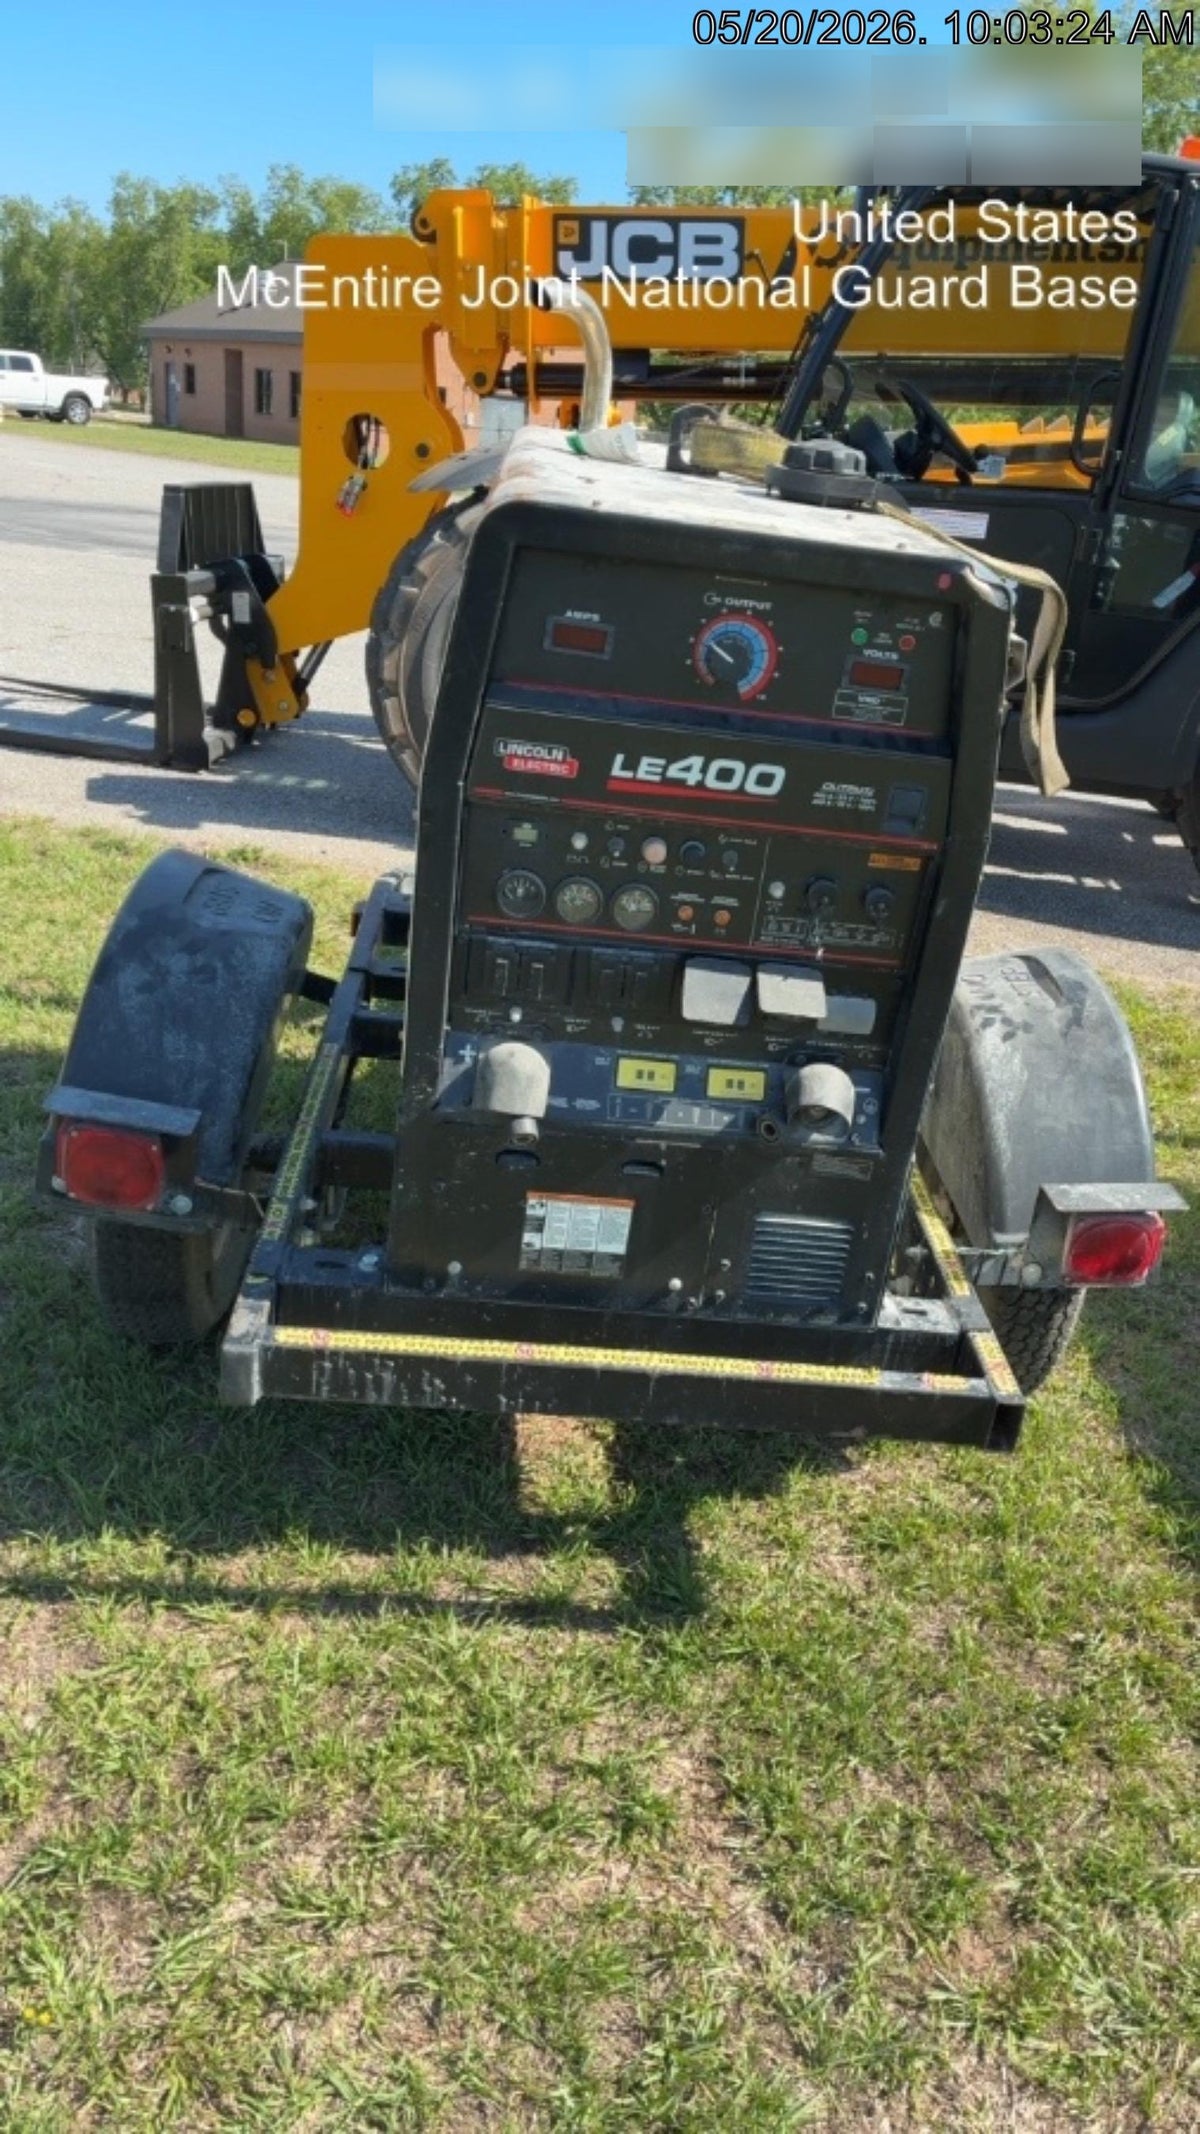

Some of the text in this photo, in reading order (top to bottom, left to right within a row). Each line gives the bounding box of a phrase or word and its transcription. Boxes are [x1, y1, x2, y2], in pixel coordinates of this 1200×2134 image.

[557, 219, 740, 279] JCB
[725, 597, 772, 610] OUTPUT
[565, 608, 601, 622] AMPS
[863, 649, 899, 661] VOLTS
[500, 741, 564, 762] LINCOLN
[512, 757, 570, 775] ELECTRIC
[611, 752, 786, 796] LE400
